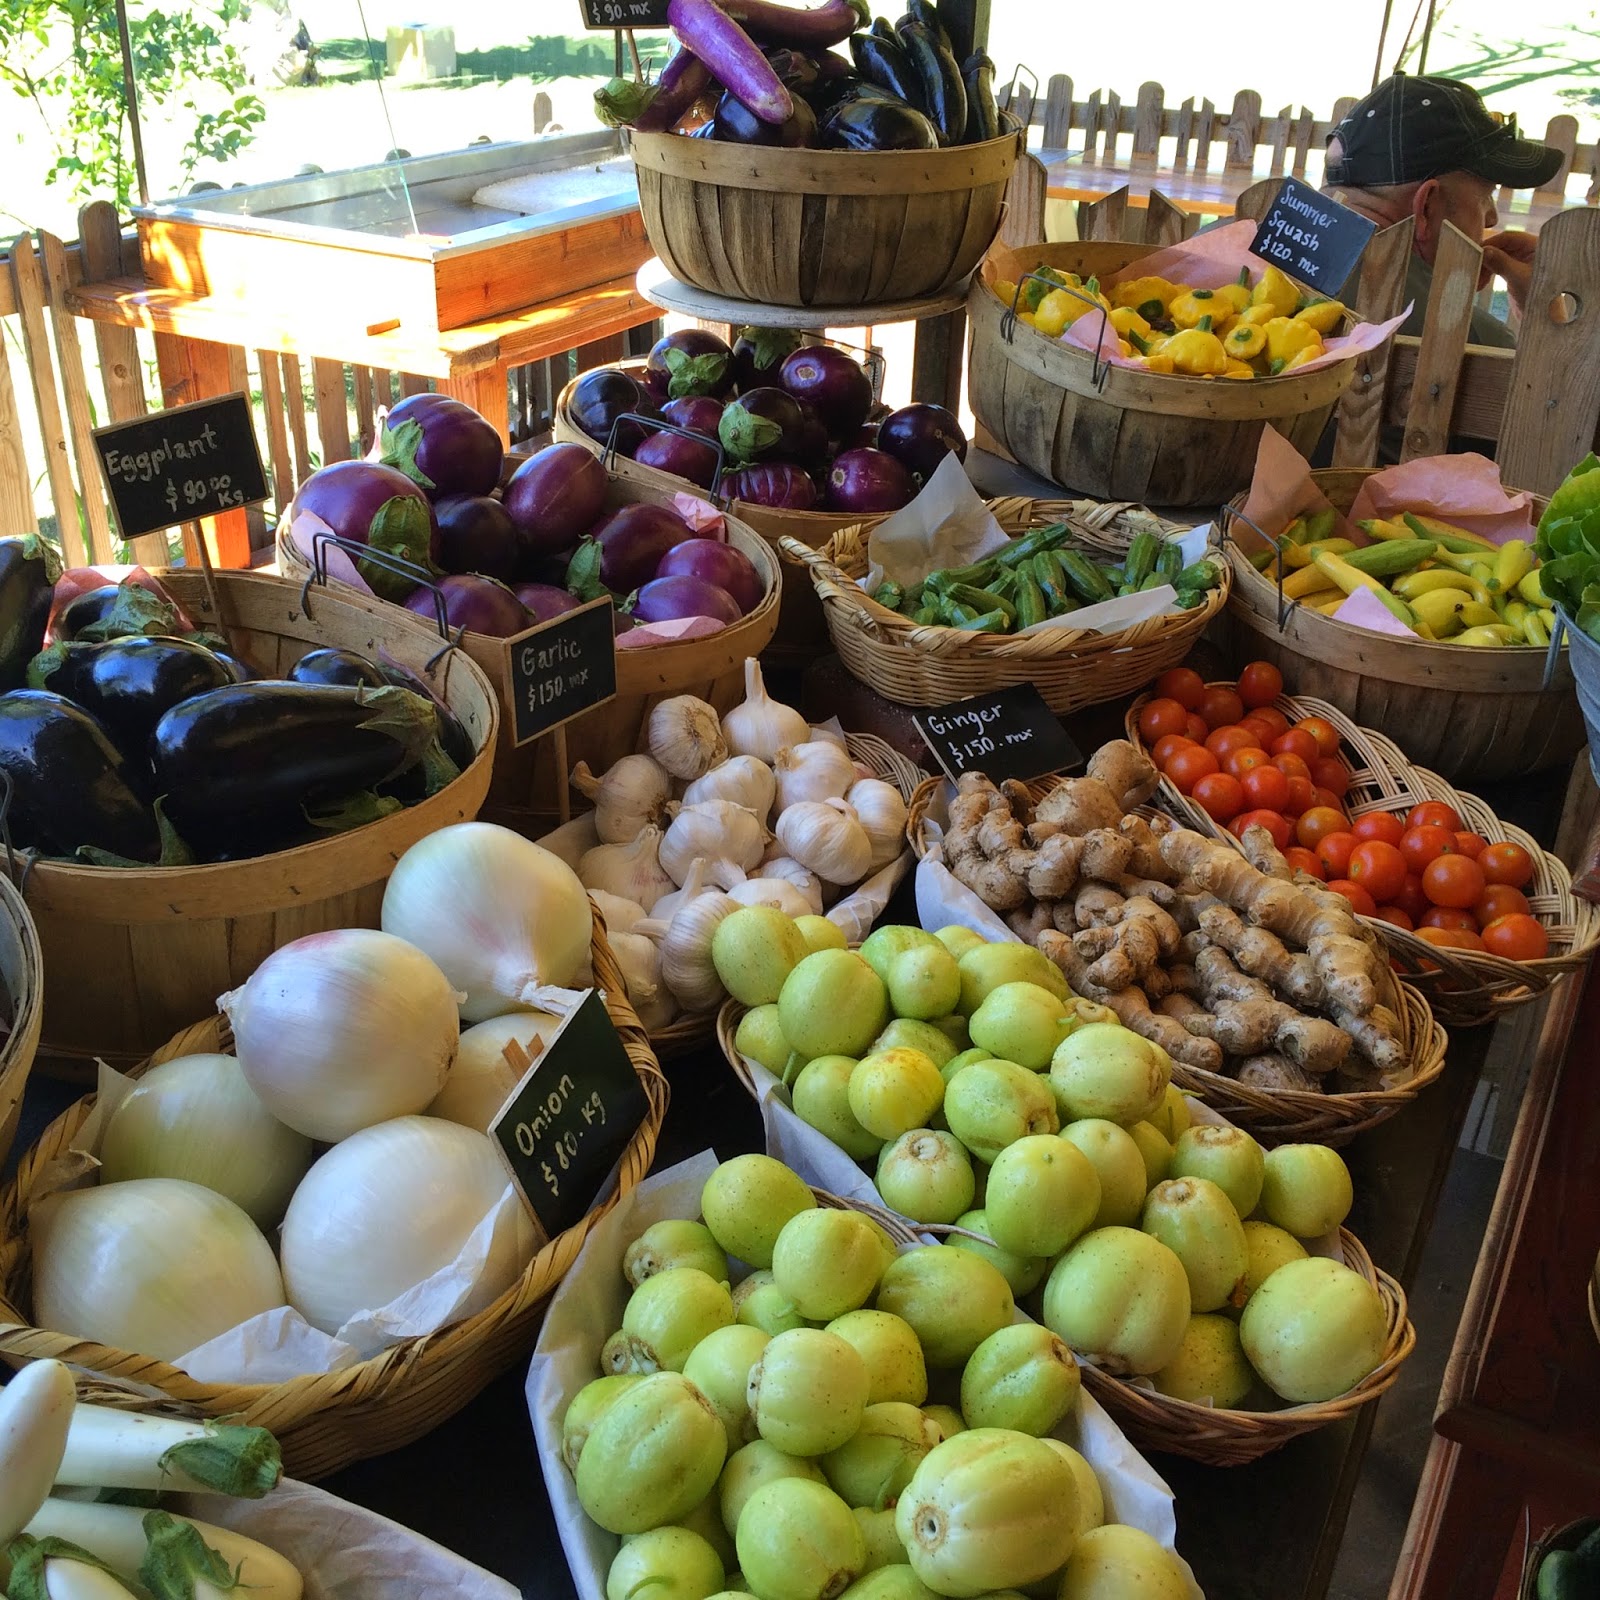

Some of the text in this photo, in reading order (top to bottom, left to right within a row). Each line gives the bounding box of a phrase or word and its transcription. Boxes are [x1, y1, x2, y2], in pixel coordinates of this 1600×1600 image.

[629, 1, 651, 15] mx
[1280, 184, 1338, 229] Summer
[1268, 210, 1320, 252] Squash
[1297, 256, 1320, 277] mx
[105, 423, 218, 483] Eggplant
[521, 638, 582, 676] Garlic
[569, 668, 589, 688] mx
[927, 704, 1002, 735] Ginger
[1005, 728, 1034, 744] mx
